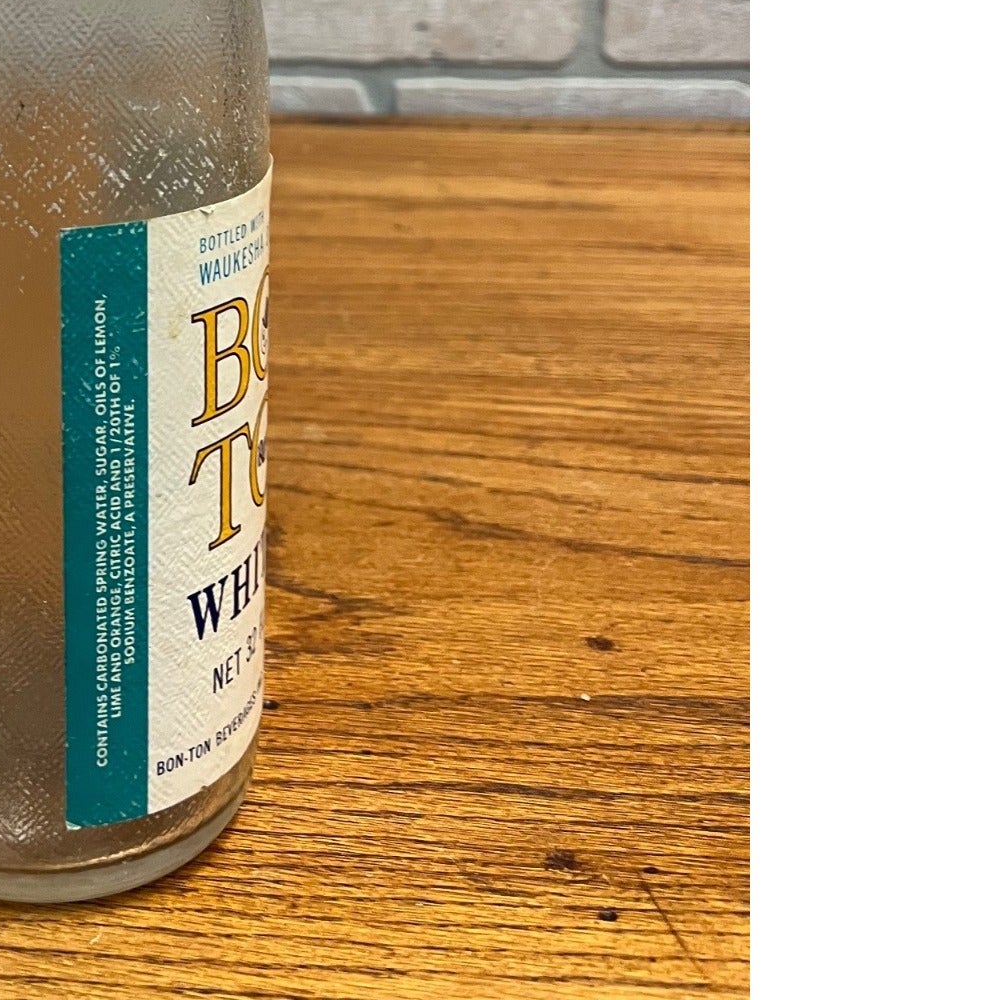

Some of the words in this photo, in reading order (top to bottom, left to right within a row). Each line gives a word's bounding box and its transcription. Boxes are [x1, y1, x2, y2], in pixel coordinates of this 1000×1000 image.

[200, 223, 247, 254] BOTTLED
[94, 293, 107, 355] LEMON,
[94, 357, 106, 379] OF
[109, 373, 121, 394] OF
[94, 381, 106, 417] OILS
[95, 420, 108, 477] SUGAR,
[124, 398, 135, 508] PRESERVATIVE.
[110, 459, 121, 493] AND
[95, 479, 108, 536] WATER,
[110, 496, 121, 531] ACID
[124, 511, 135, 523] A
[95, 539, 107, 594] SPRING
[110, 533, 121, 580] CITRIC
[124, 525, 136, 605] BENZOATE,
[110, 582, 122, 649] ORANGE,
[124, 607, 135, 666] SODIUM
[96, 597, 108, 692] CARBONATED
[110, 652, 121, 683] AND
[213, 647, 242, 694] NET
[110, 685, 121, 719] LIME
[96, 694, 108, 768] CONTAINS
[157, 738, 211, 776] BON-TON
